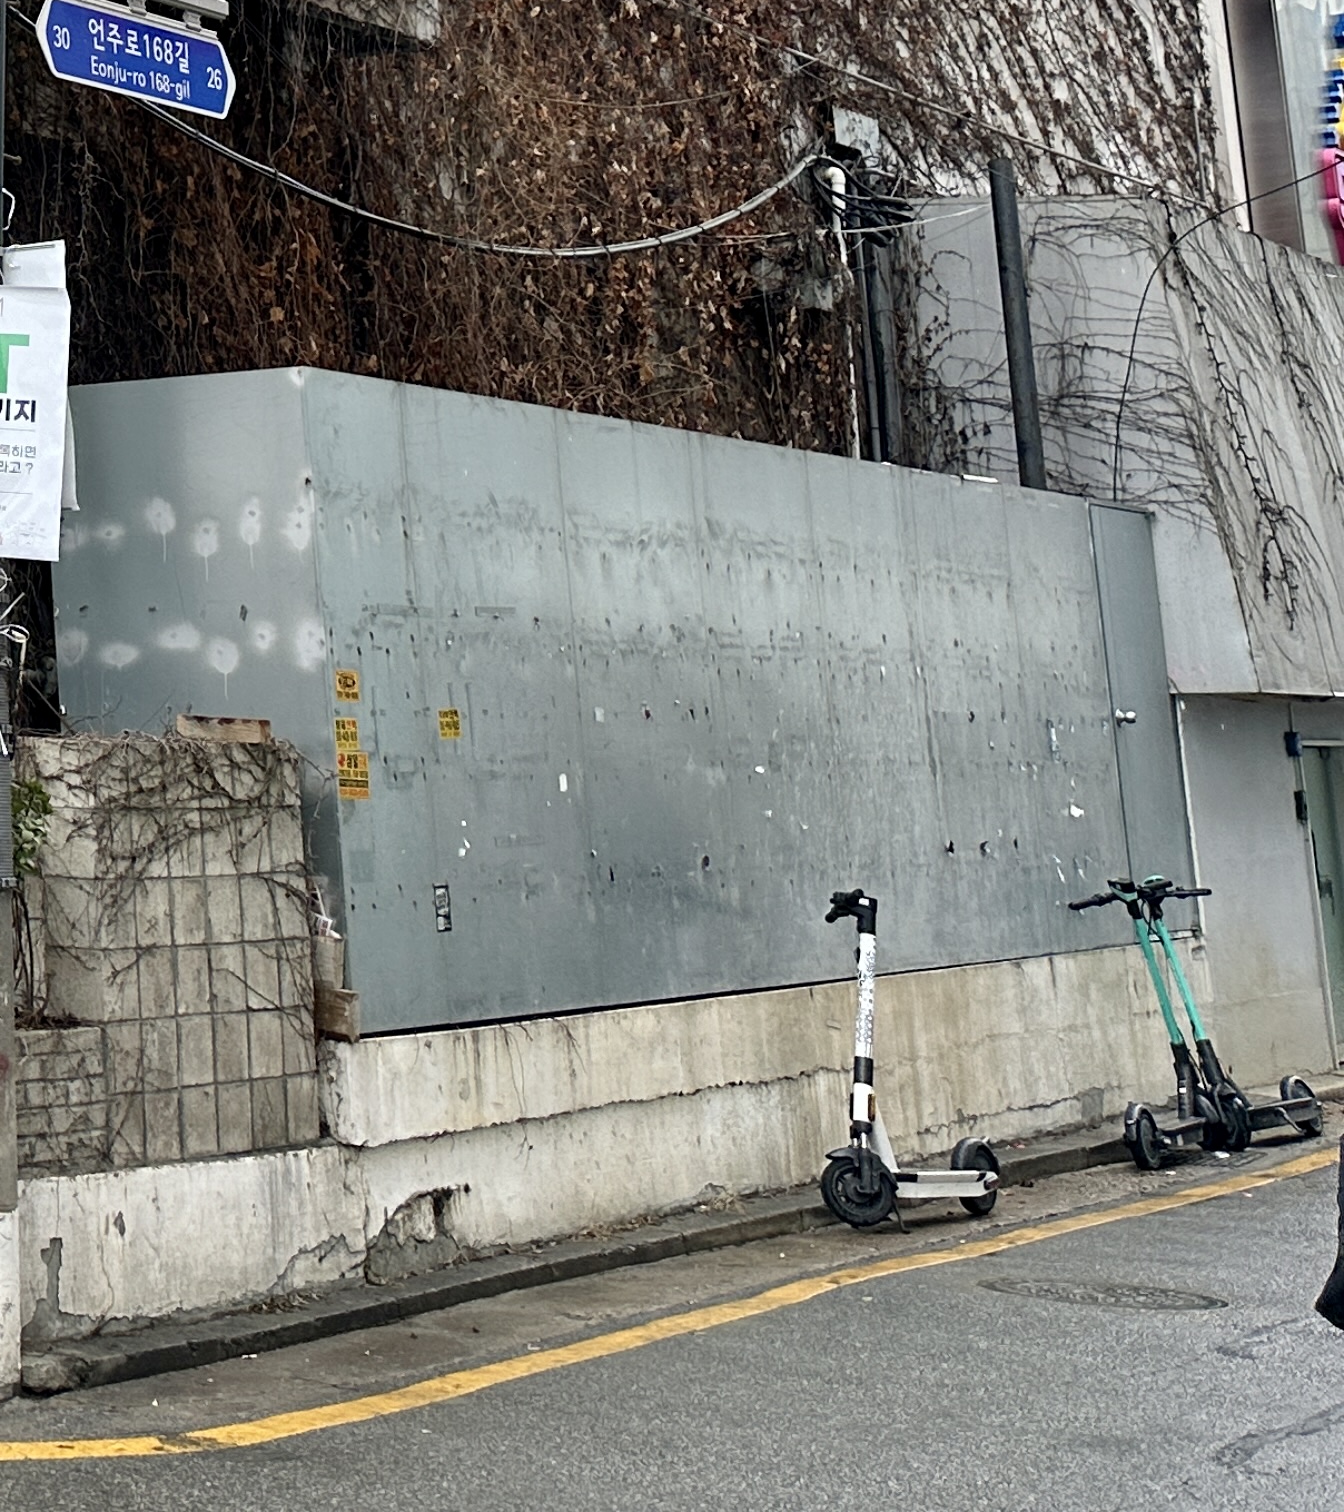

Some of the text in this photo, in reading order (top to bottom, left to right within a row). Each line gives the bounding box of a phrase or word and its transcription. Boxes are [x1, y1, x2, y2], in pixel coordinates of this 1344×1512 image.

[52, 25, 71, 50] 30
[88, 18, 190, 75] 언주로168길
[90, 55, 190, 101] Eonju-ro 168-gil
[206, 66, 223, 91] 26
